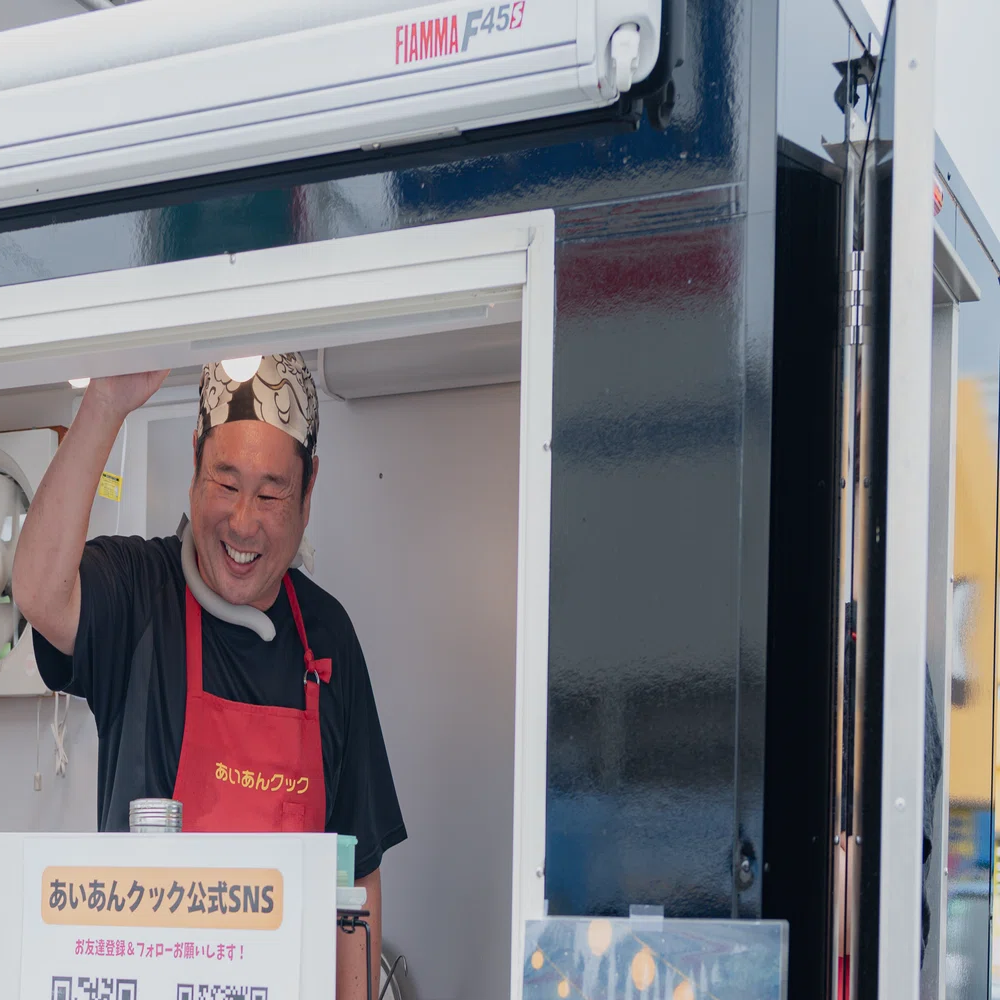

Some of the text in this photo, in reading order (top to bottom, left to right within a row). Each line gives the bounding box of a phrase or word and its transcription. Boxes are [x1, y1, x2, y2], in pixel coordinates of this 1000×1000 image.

[395, 14, 458, 65] FIAMMA
[215, 761, 309, 794] あいあんクック
[48, 878, 275, 915] あいあんクック公式SNS
